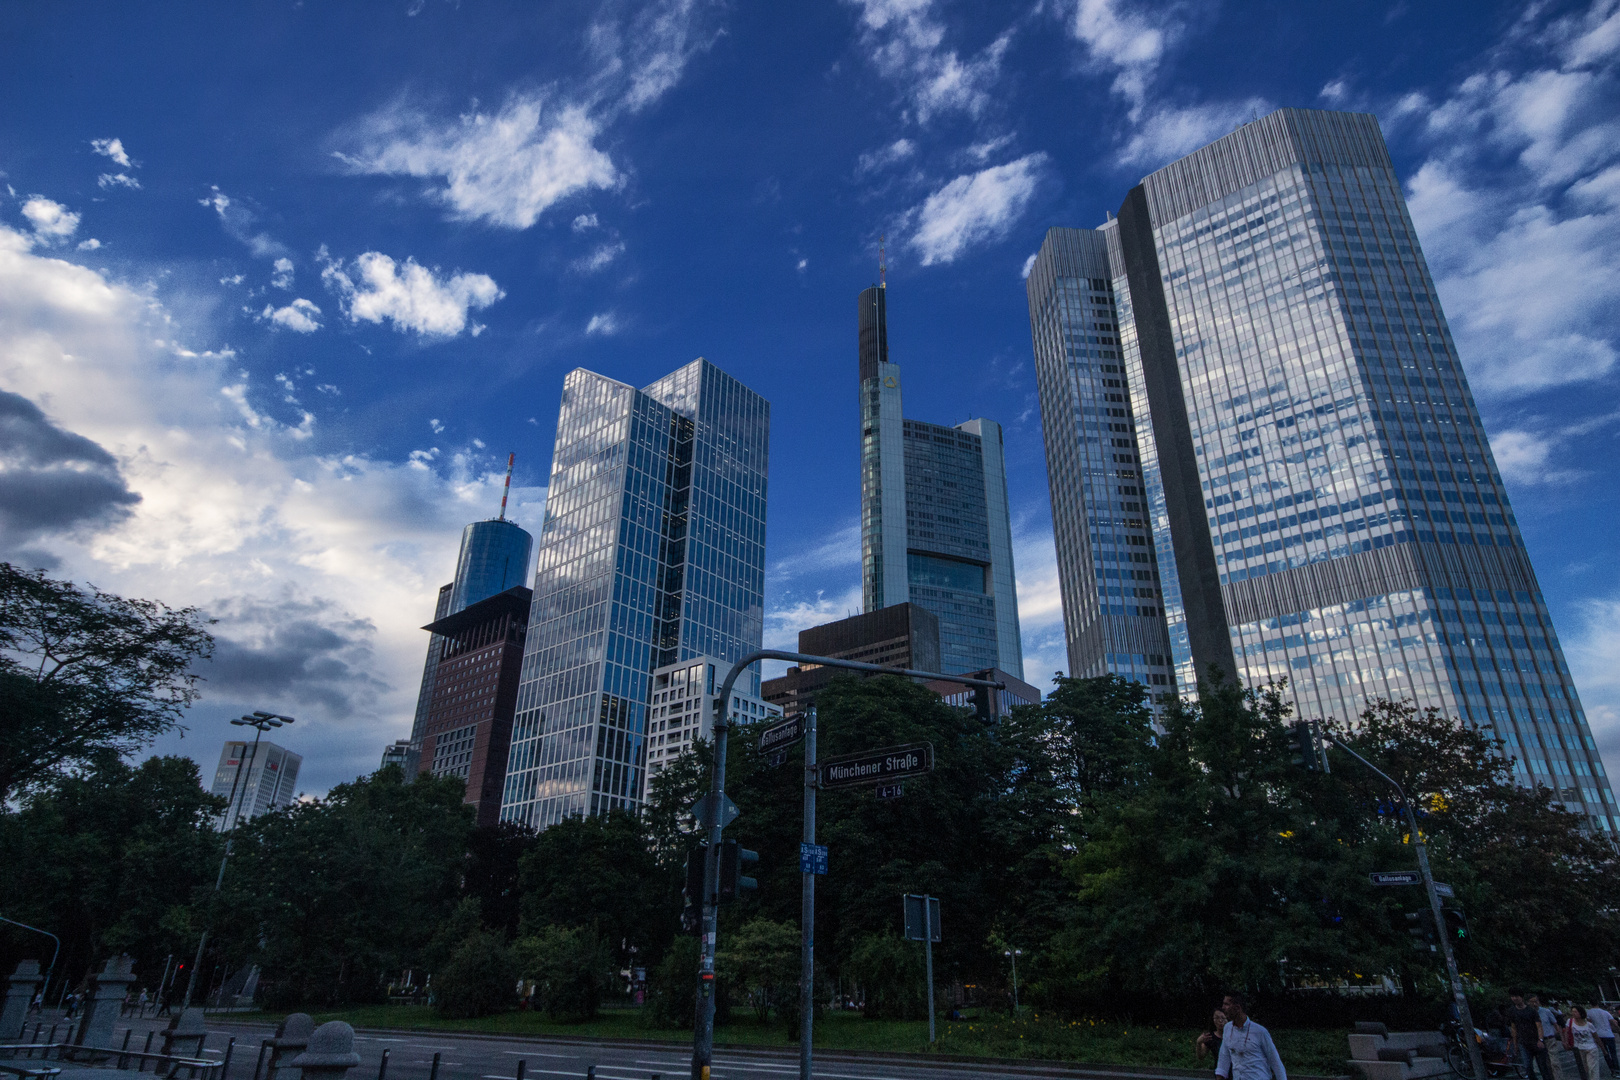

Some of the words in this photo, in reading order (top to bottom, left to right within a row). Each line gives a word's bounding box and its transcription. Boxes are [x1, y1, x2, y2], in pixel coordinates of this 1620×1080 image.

[762, 725, 798, 746] Gallusanlage
[830, 762, 882, 780] Münchener
[886, 754, 918, 771] Straße
[882, 785, 902, 798] 4-16
